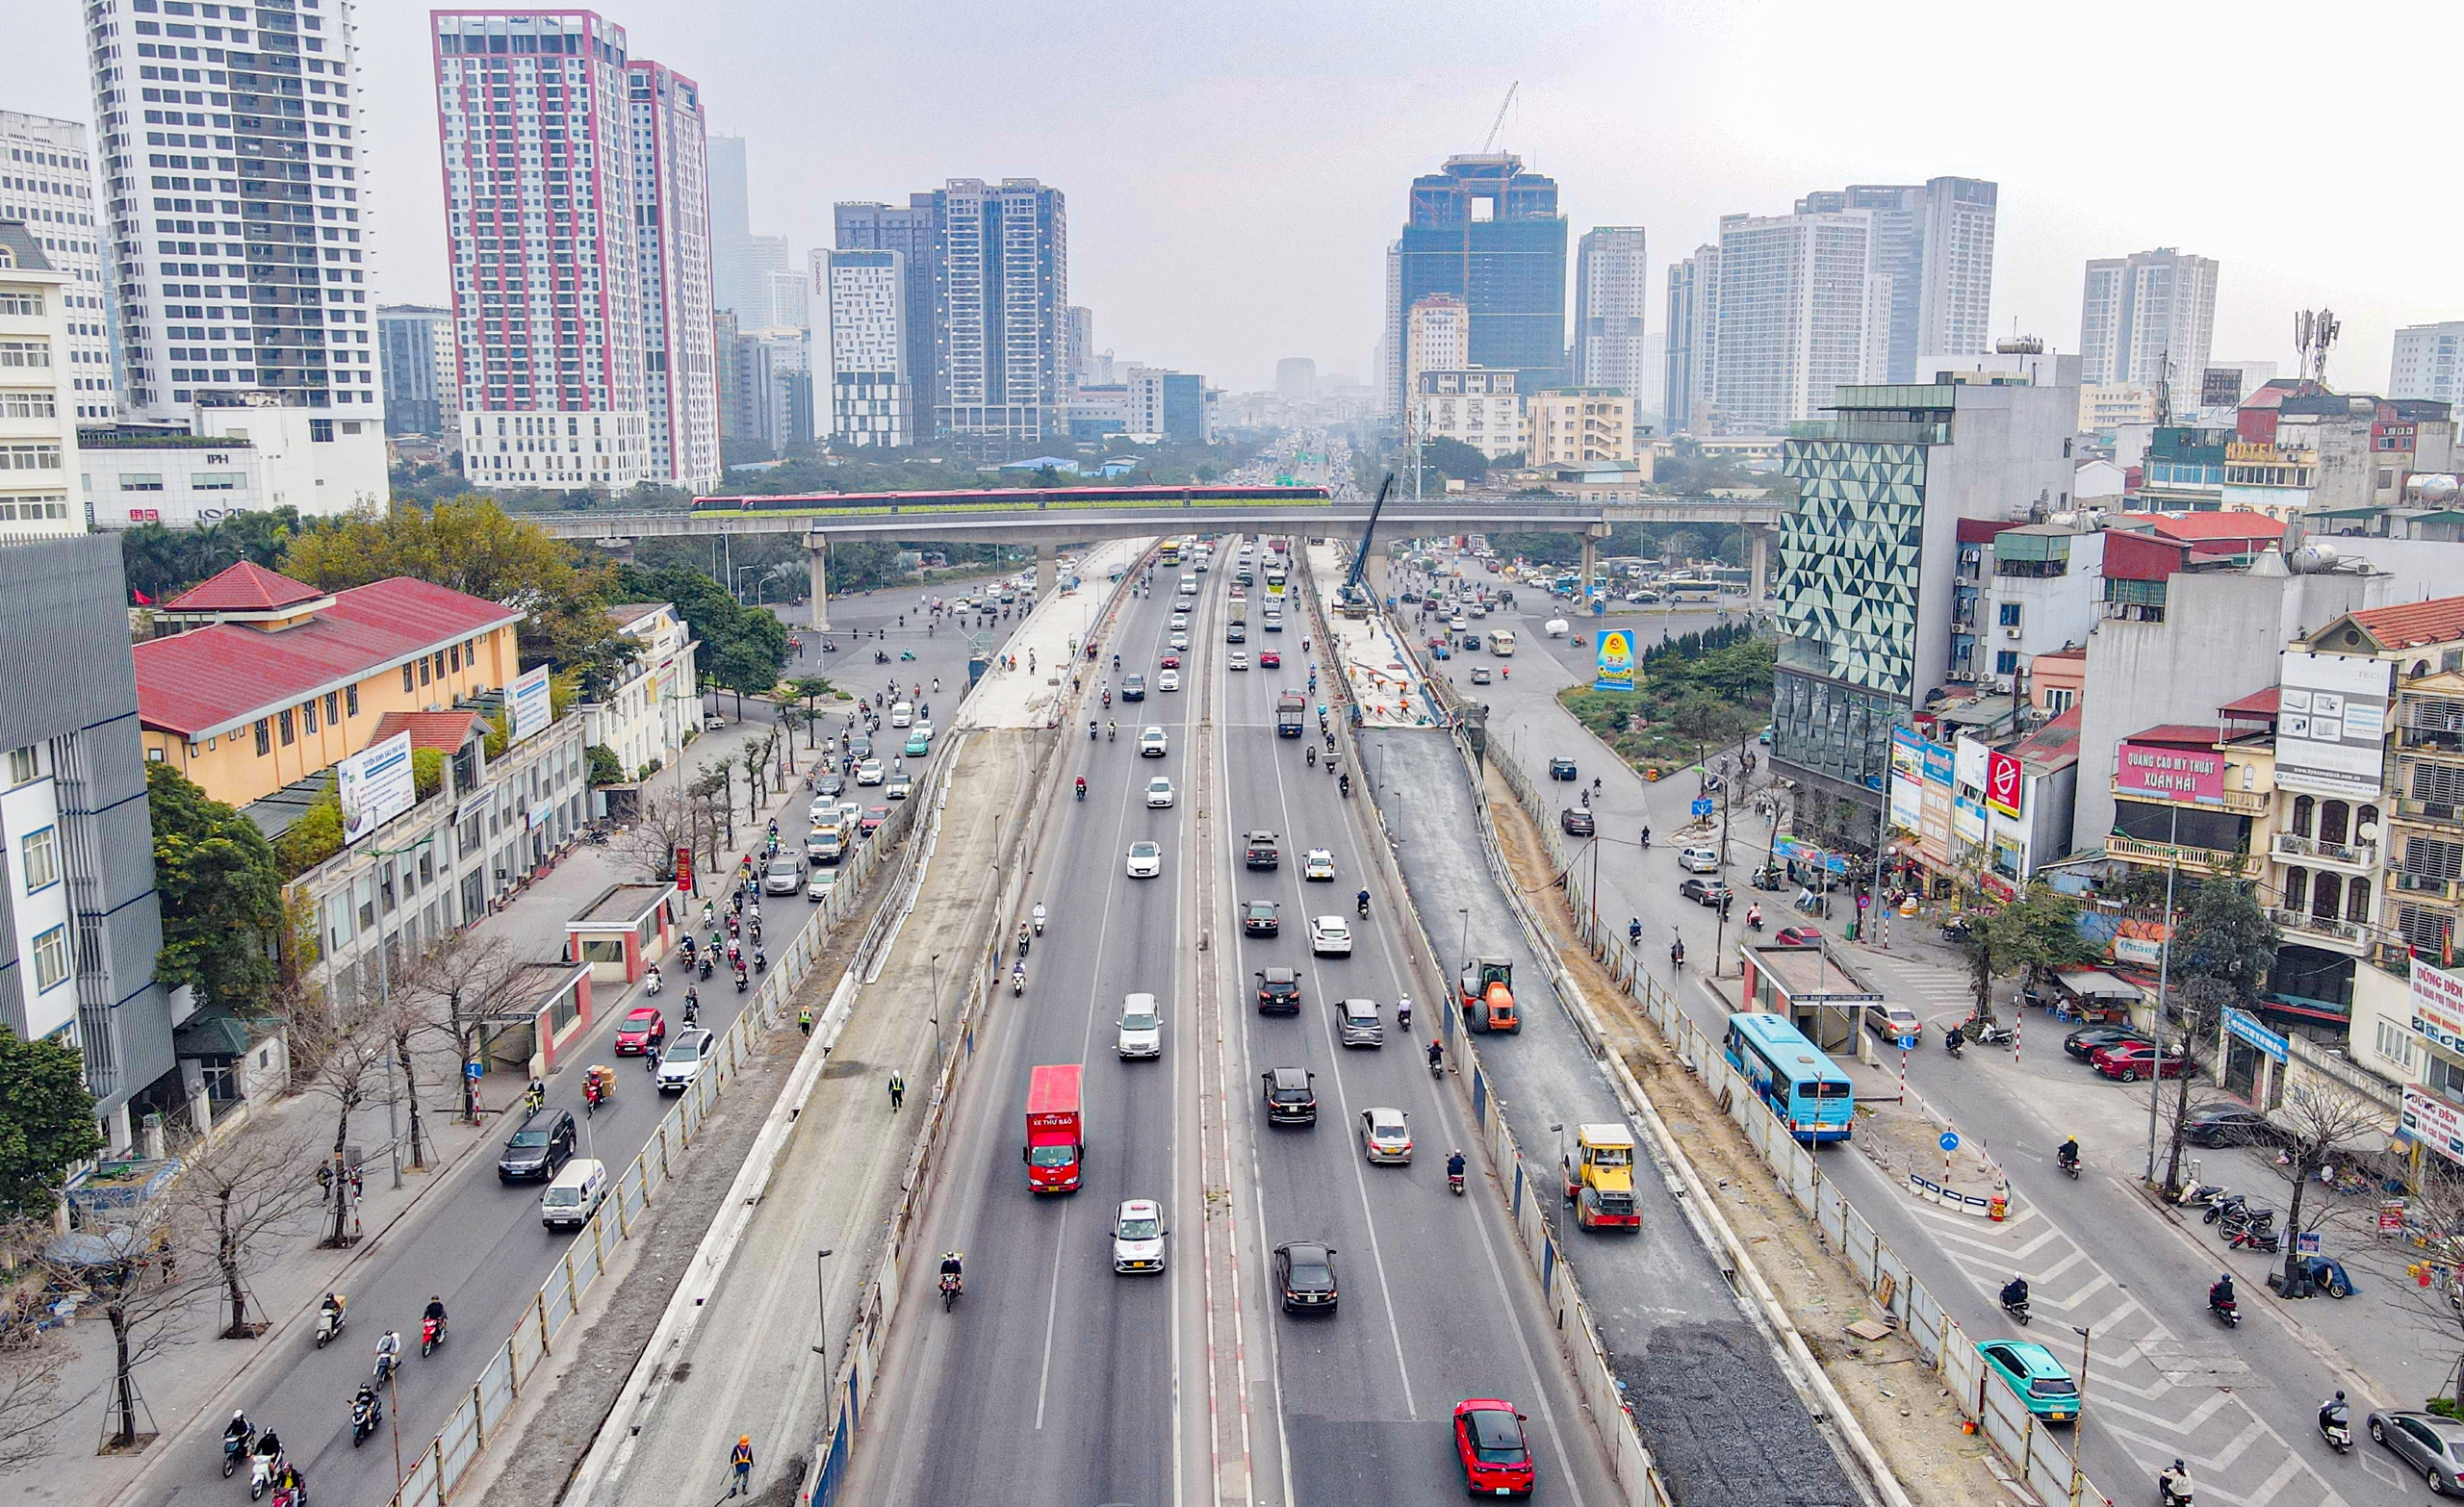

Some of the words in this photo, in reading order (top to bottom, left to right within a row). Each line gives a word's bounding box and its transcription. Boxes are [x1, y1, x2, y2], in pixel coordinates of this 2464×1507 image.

[207, 454, 228, 464] IPH
[2226, 443, 2276, 461] HOTEL
[2127, 751, 2154, 767] QUẢNG
[2190, 759, 2215, 777] THUẬT
[2144, 771, 2173, 789] XUÂN
[2175, 773, 2195, 791] HẢI
